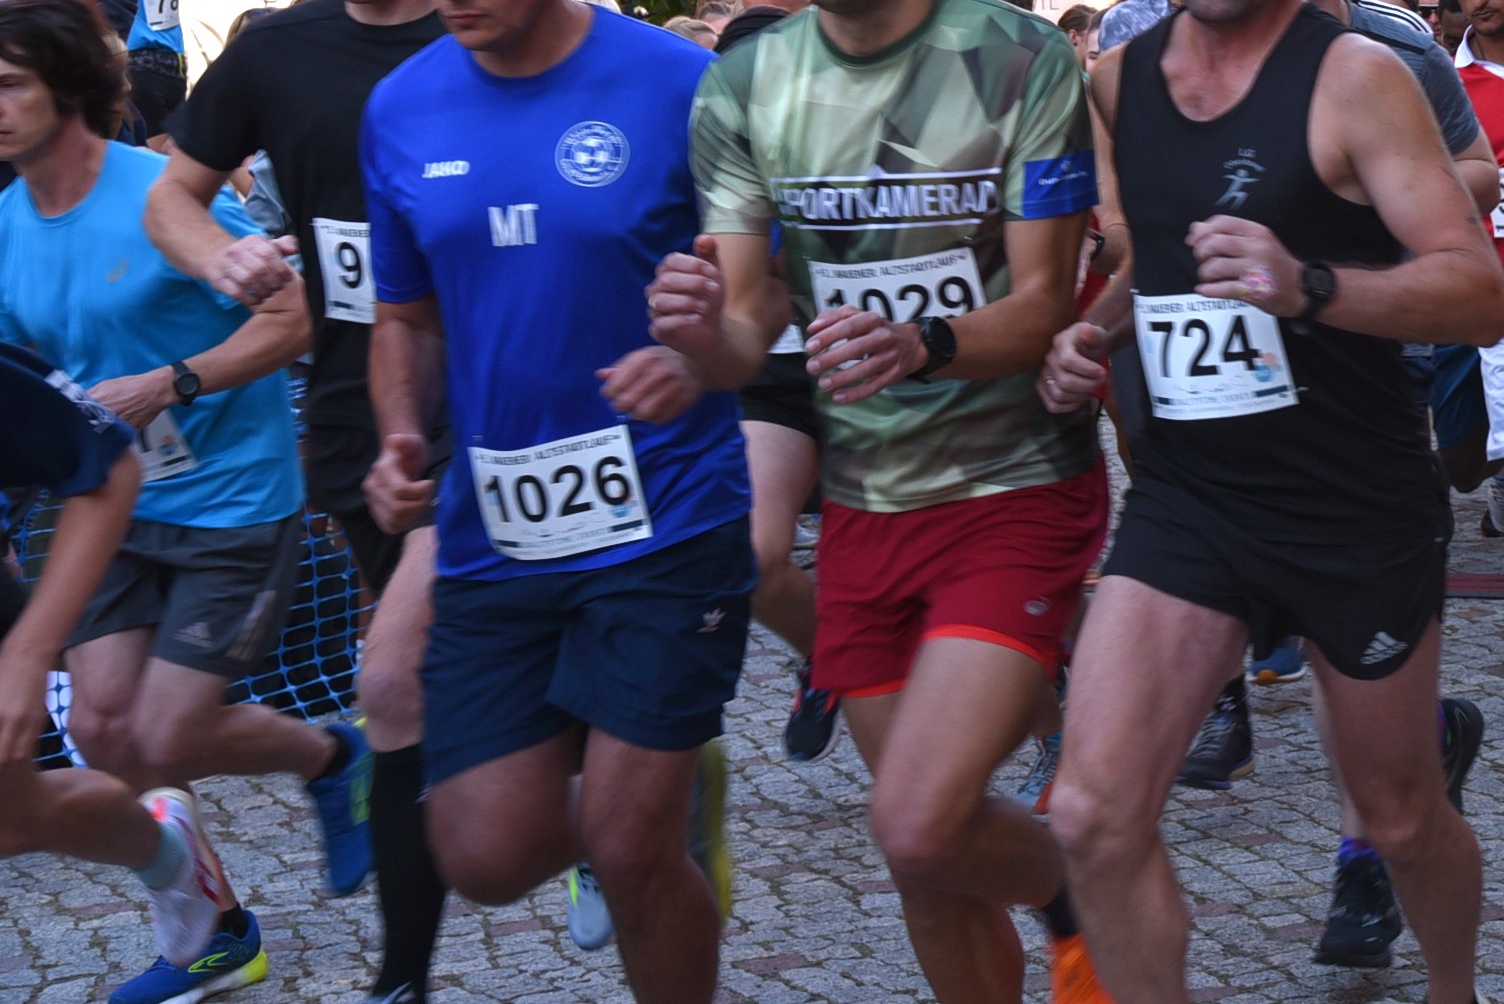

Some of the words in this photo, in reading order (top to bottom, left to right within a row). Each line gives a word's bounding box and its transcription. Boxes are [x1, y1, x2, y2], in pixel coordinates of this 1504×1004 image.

[488, 203, 539, 246] MT
[1148, 314, 1264, 378] 724
[485, 455, 631, 523] 1026
